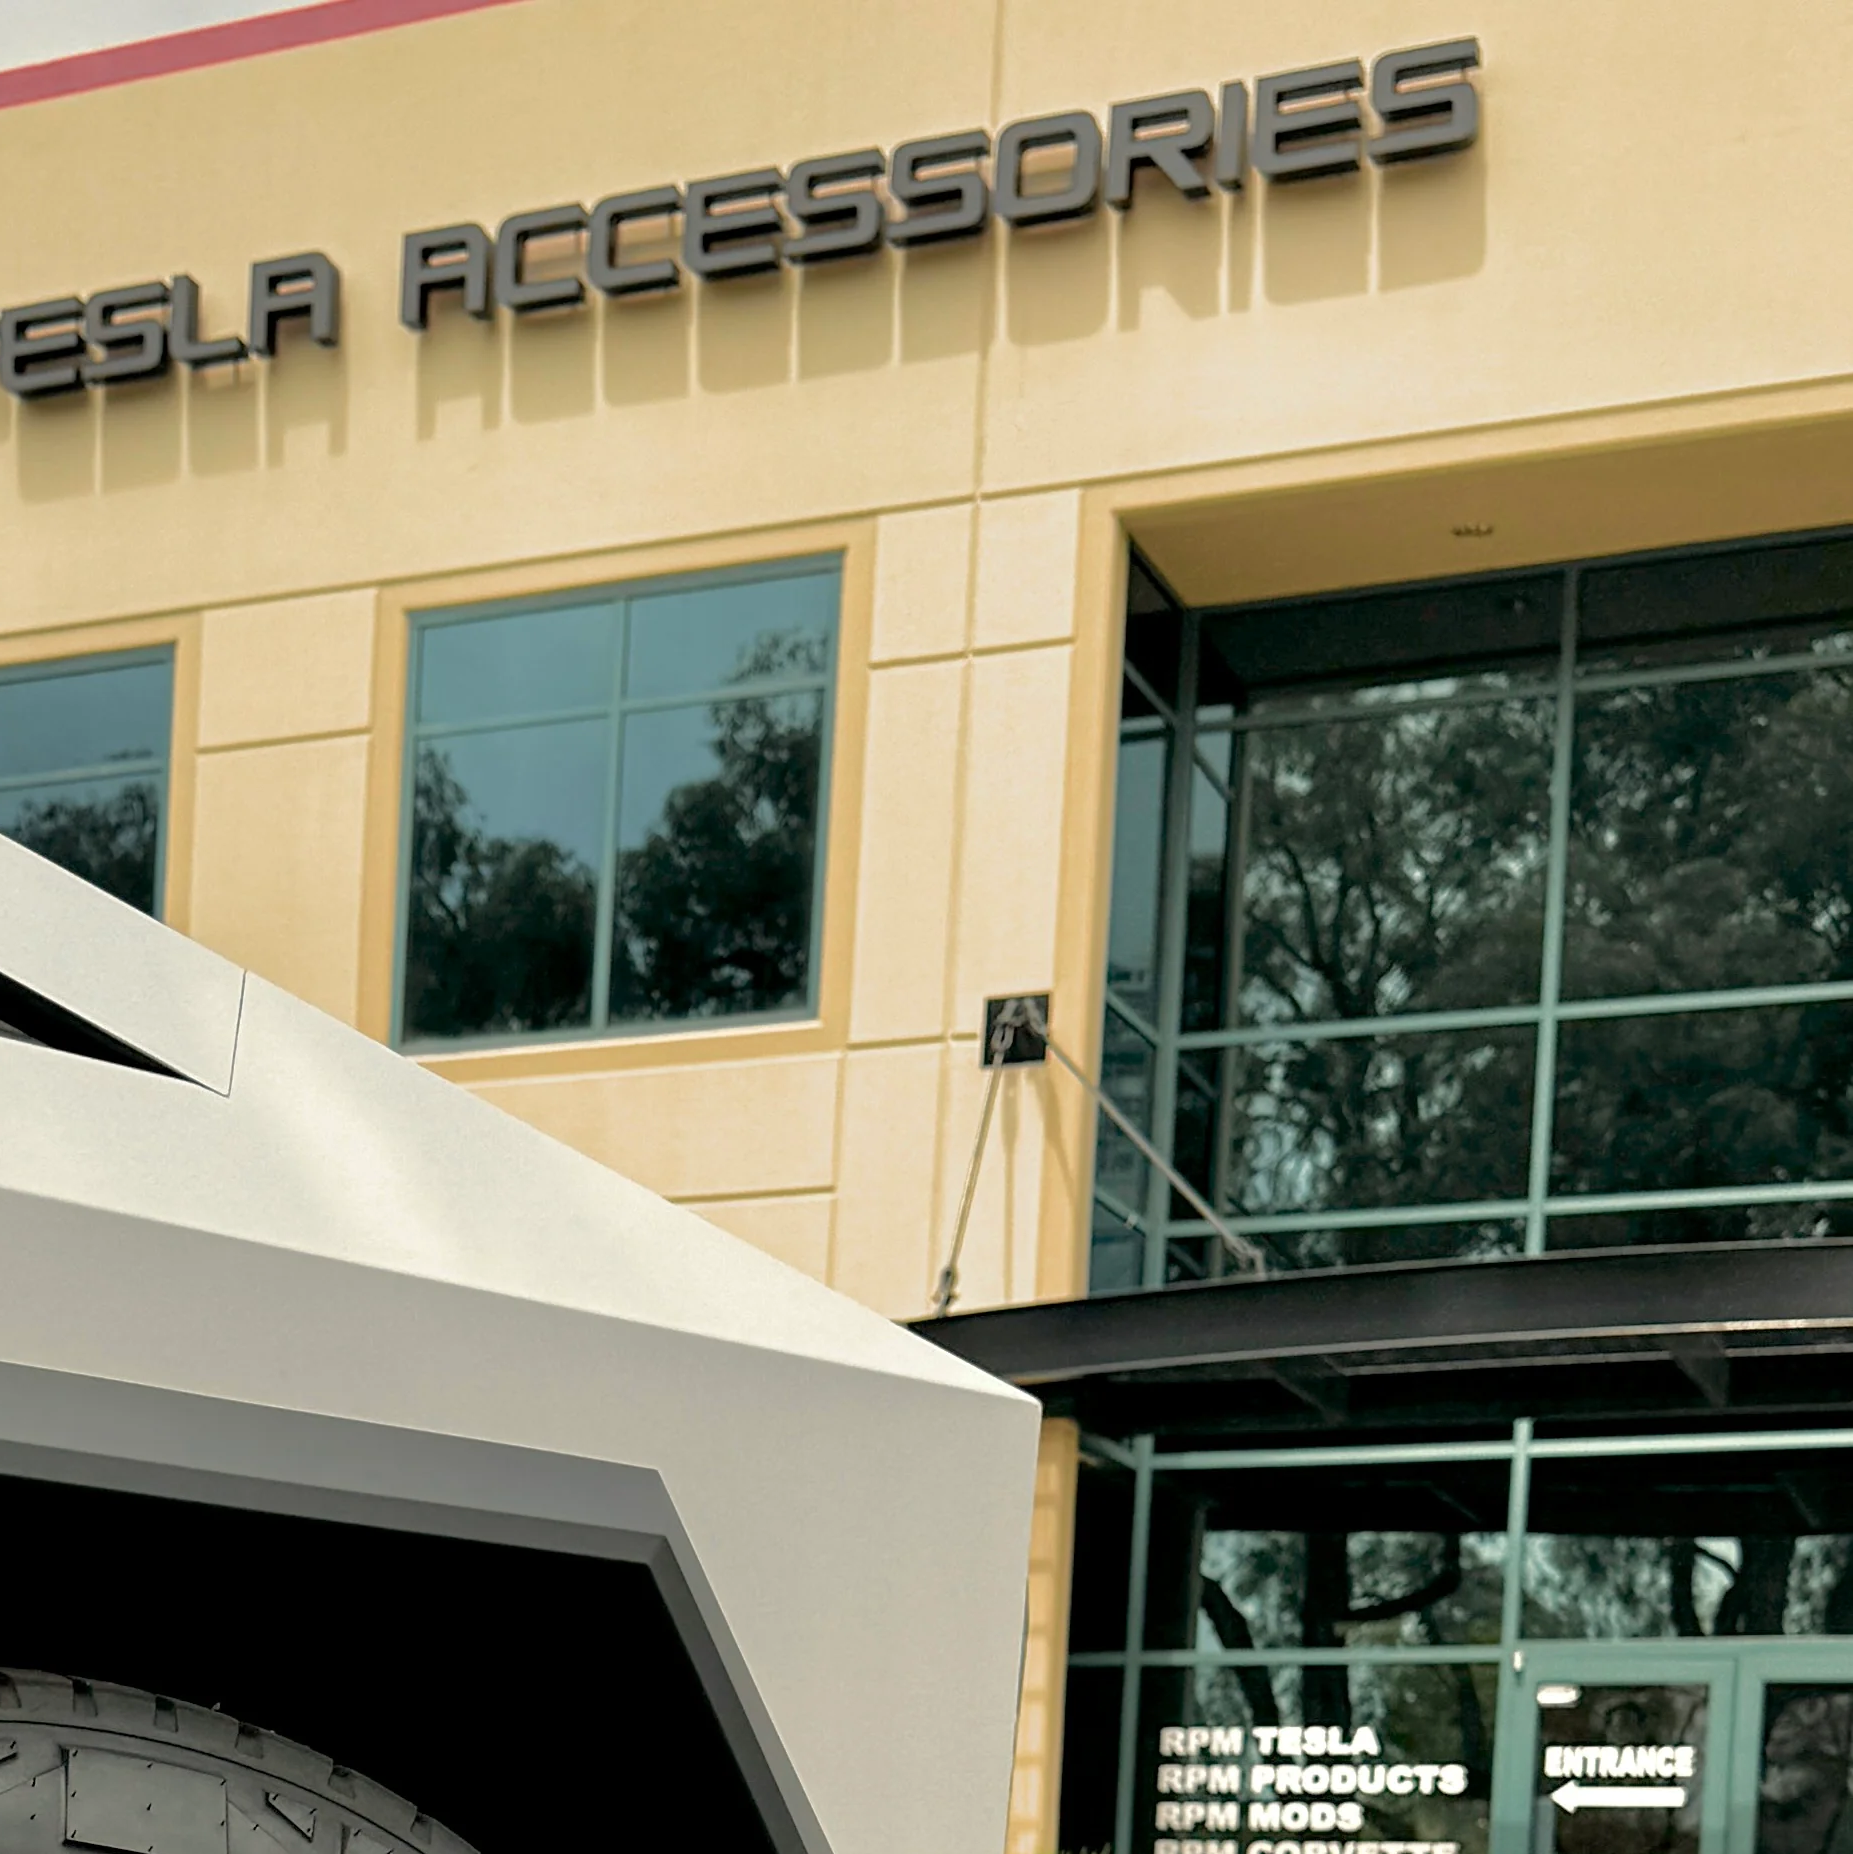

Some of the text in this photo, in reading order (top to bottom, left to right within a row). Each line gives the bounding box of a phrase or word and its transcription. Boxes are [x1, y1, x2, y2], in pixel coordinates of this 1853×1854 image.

[399, 36, 1482, 332] ACCESSORIES
[1158, 1725, 1380, 1757] RPM TESLA
[1543, 1744, 1698, 1778] ENTRANCE
[1156, 1763, 1469, 1796] RPM PRODUCTS
[1154, 1800, 1363, 1833] RPM MODS
